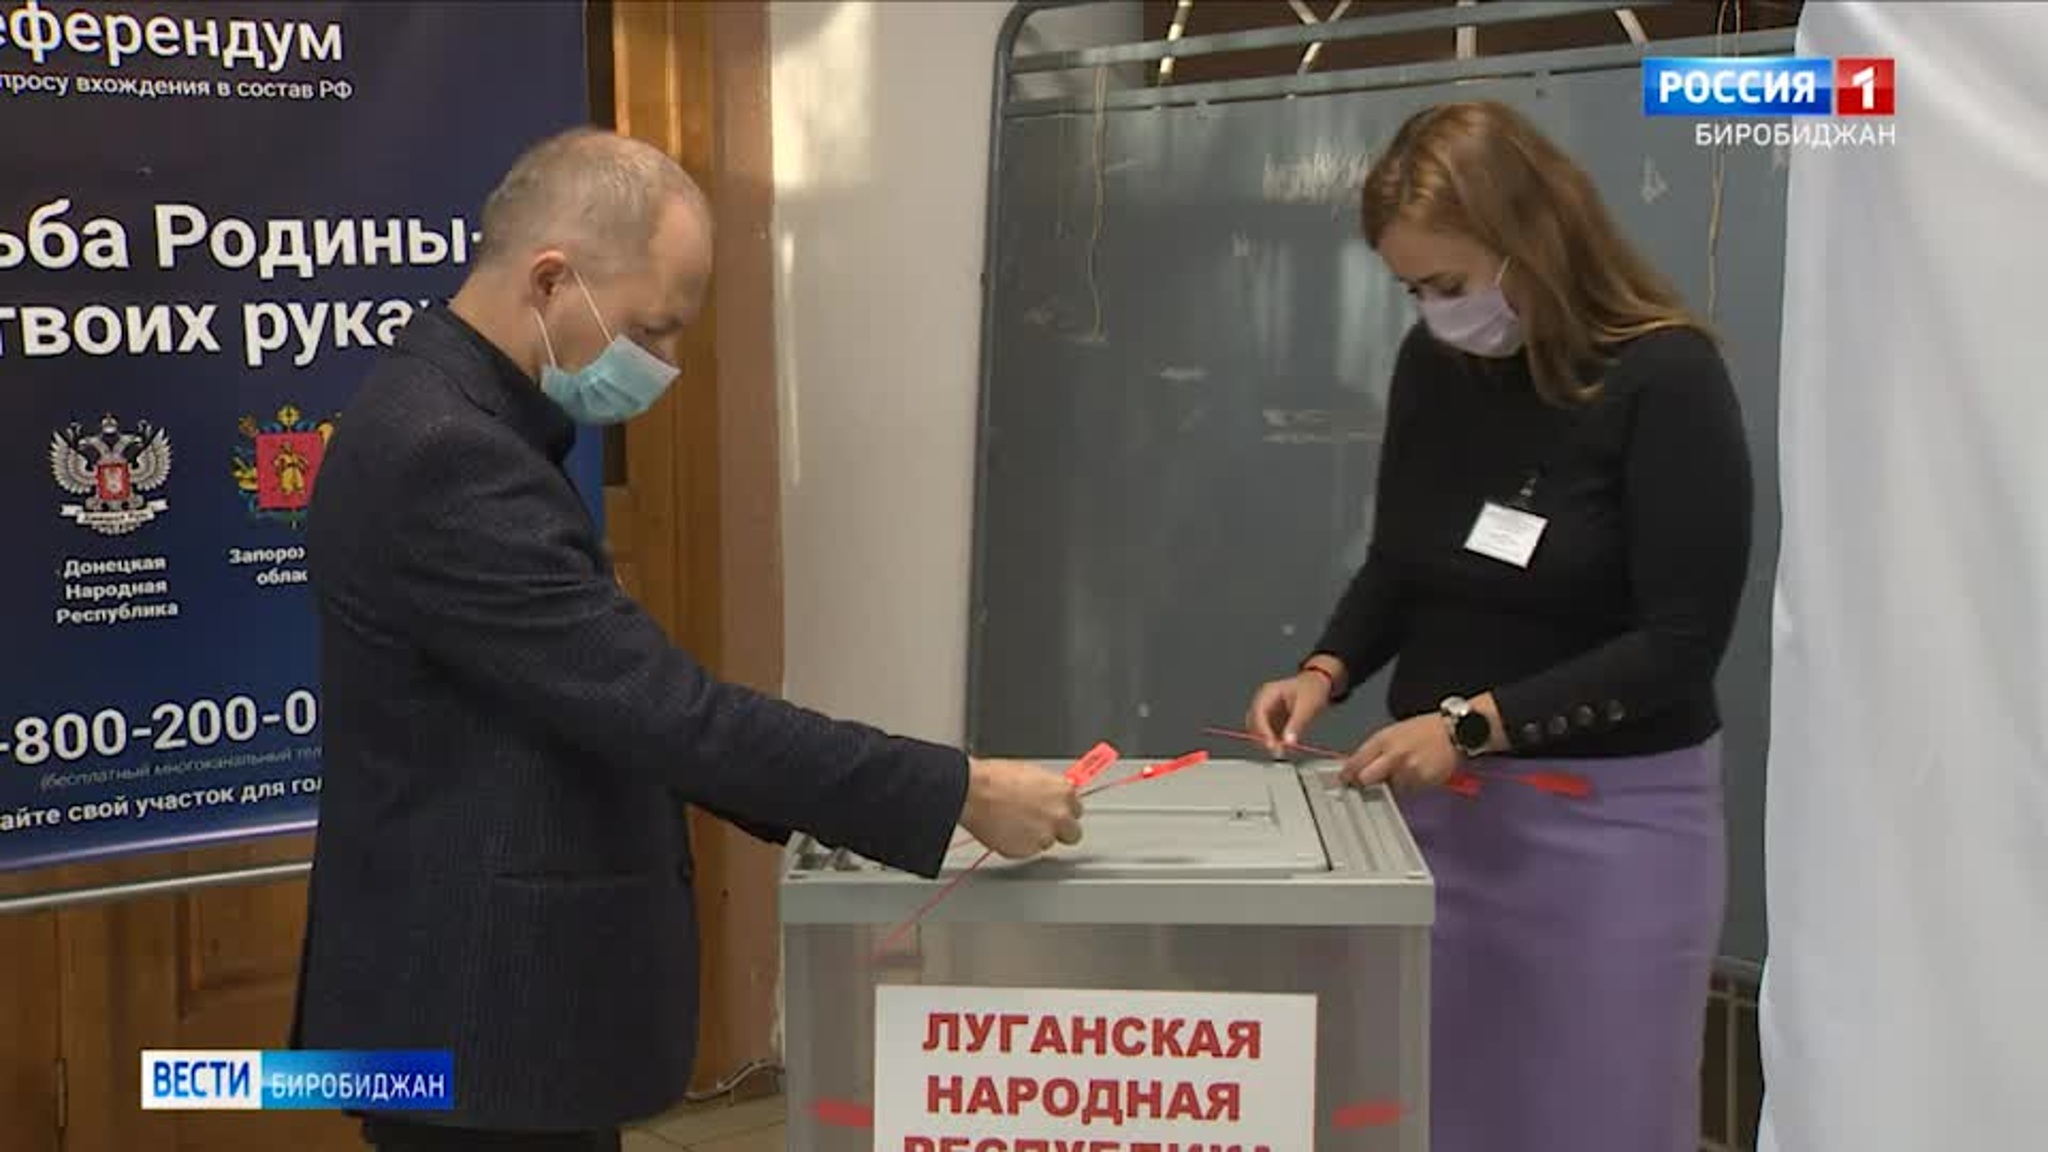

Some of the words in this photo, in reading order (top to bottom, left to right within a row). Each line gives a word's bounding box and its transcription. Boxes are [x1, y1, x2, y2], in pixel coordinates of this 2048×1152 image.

[0, 0, 342, 72] ферендум
[76, 77, 210, 98] вхождения
[217, 82, 231, 97] в
[237, 83, 314, 98] состав
[320, 80, 353, 99] РФ
[244, 299, 430, 366] рука
[63, 557, 166, 578] Донецкая
[65, 580, 167, 601] Народная
[56, 602, 178, 624] Республика
[68, 795, 129, 821] свой
[136, 787, 234, 818] участок
[241, 782, 285, 803] для
[922, 1012, 1261, 1059] ЛУГАНСКАЯ
[925, 1075, 1241, 1125] НАРОДНАЯ
